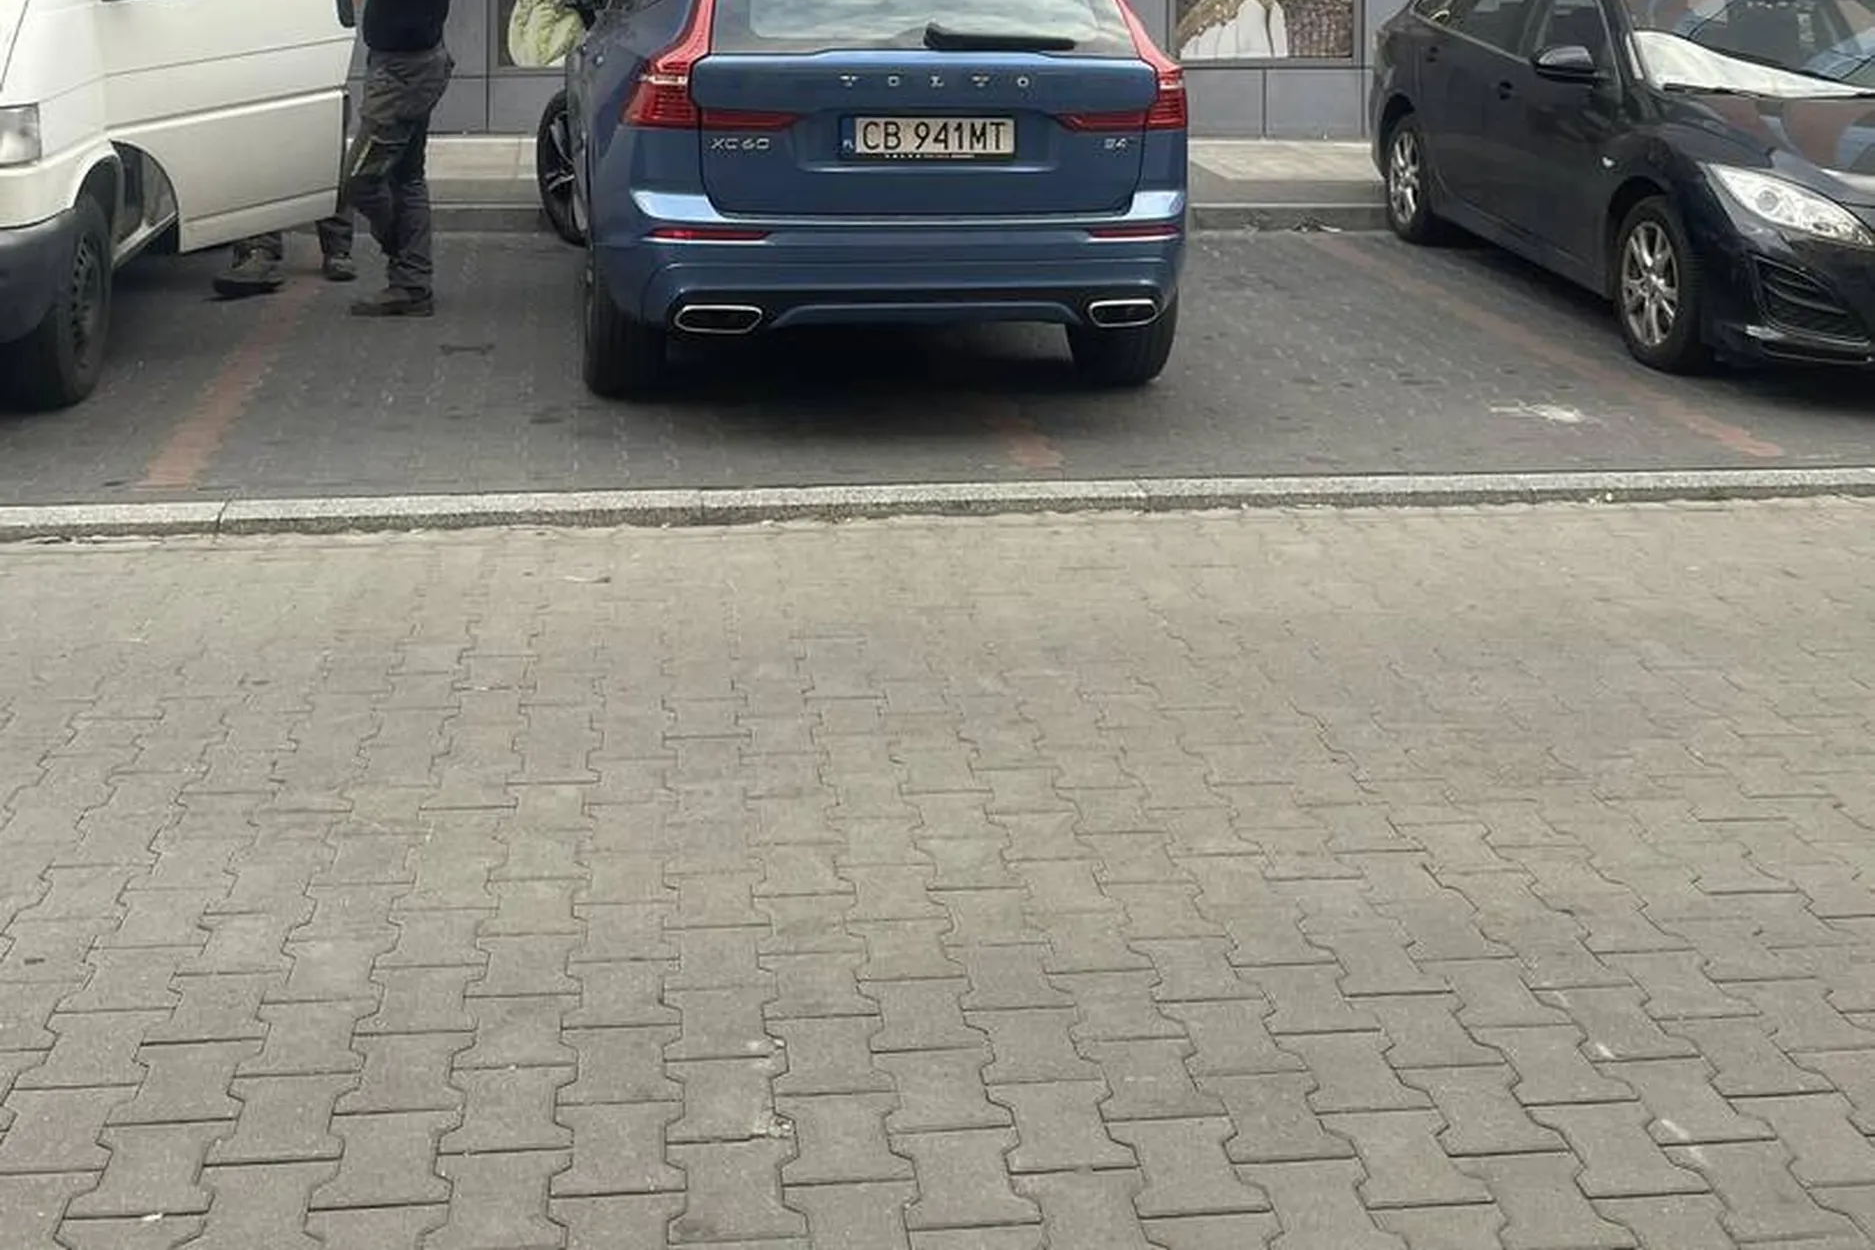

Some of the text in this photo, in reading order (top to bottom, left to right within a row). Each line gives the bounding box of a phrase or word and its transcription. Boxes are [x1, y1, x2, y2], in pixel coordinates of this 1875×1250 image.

[711, 138, 769, 149] XC60
[863, 121, 901, 150] CB
[914, 121, 1005, 150] 941MT
